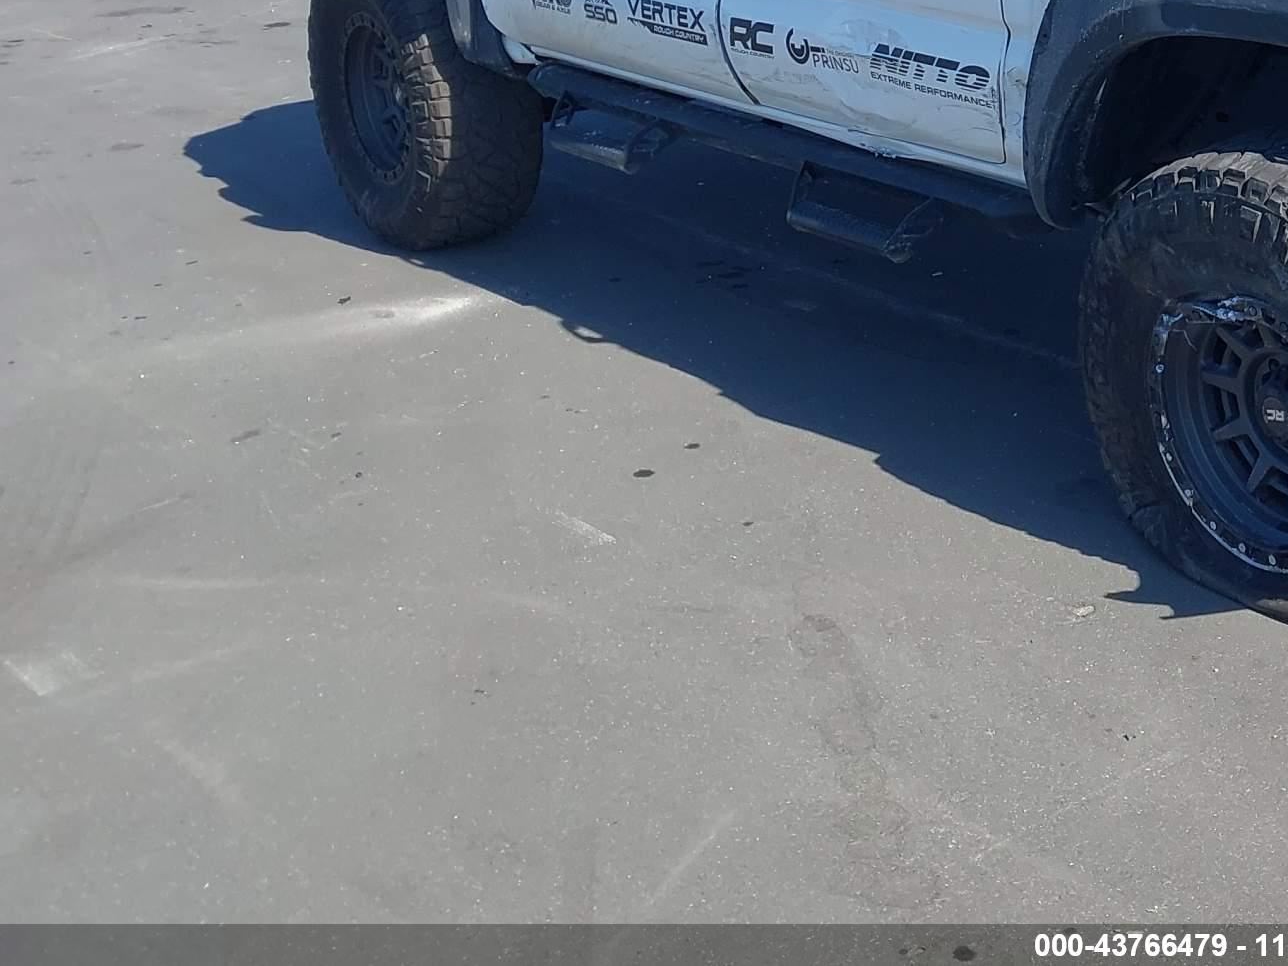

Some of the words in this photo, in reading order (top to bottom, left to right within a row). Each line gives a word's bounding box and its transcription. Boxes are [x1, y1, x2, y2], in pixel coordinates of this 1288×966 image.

[653, 25, 675, 37] ROUGH
[675, 30, 704, 43] COUNTRY
[729, 16, 775, 55] RC
[812, 54, 859, 74] PRINSU
[869, 43, 991, 92] NITTO
[870, 71, 912, 90] EXTREME
